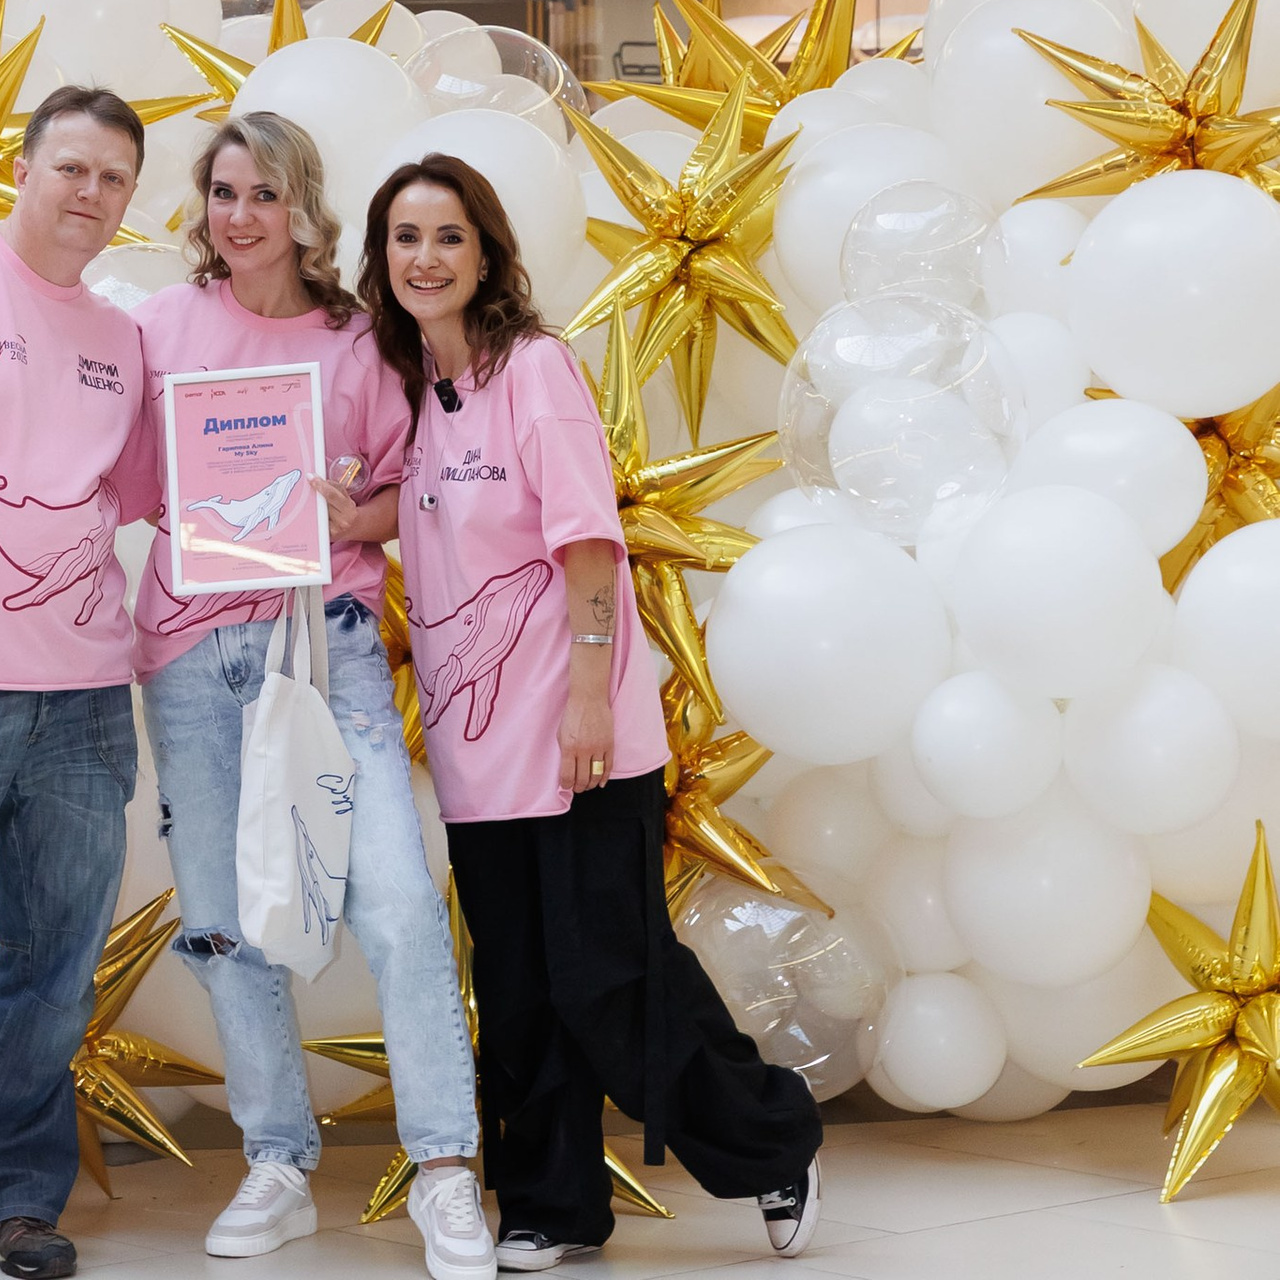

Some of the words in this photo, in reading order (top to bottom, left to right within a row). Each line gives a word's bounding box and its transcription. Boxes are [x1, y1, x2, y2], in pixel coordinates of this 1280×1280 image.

[78, 354, 119, 378] ДМИТРИЙ
[77, 369, 125, 395] ТИЩЕНКО
[203, 414, 287, 435] Диплом
[246, 449, 258, 457] Sky
